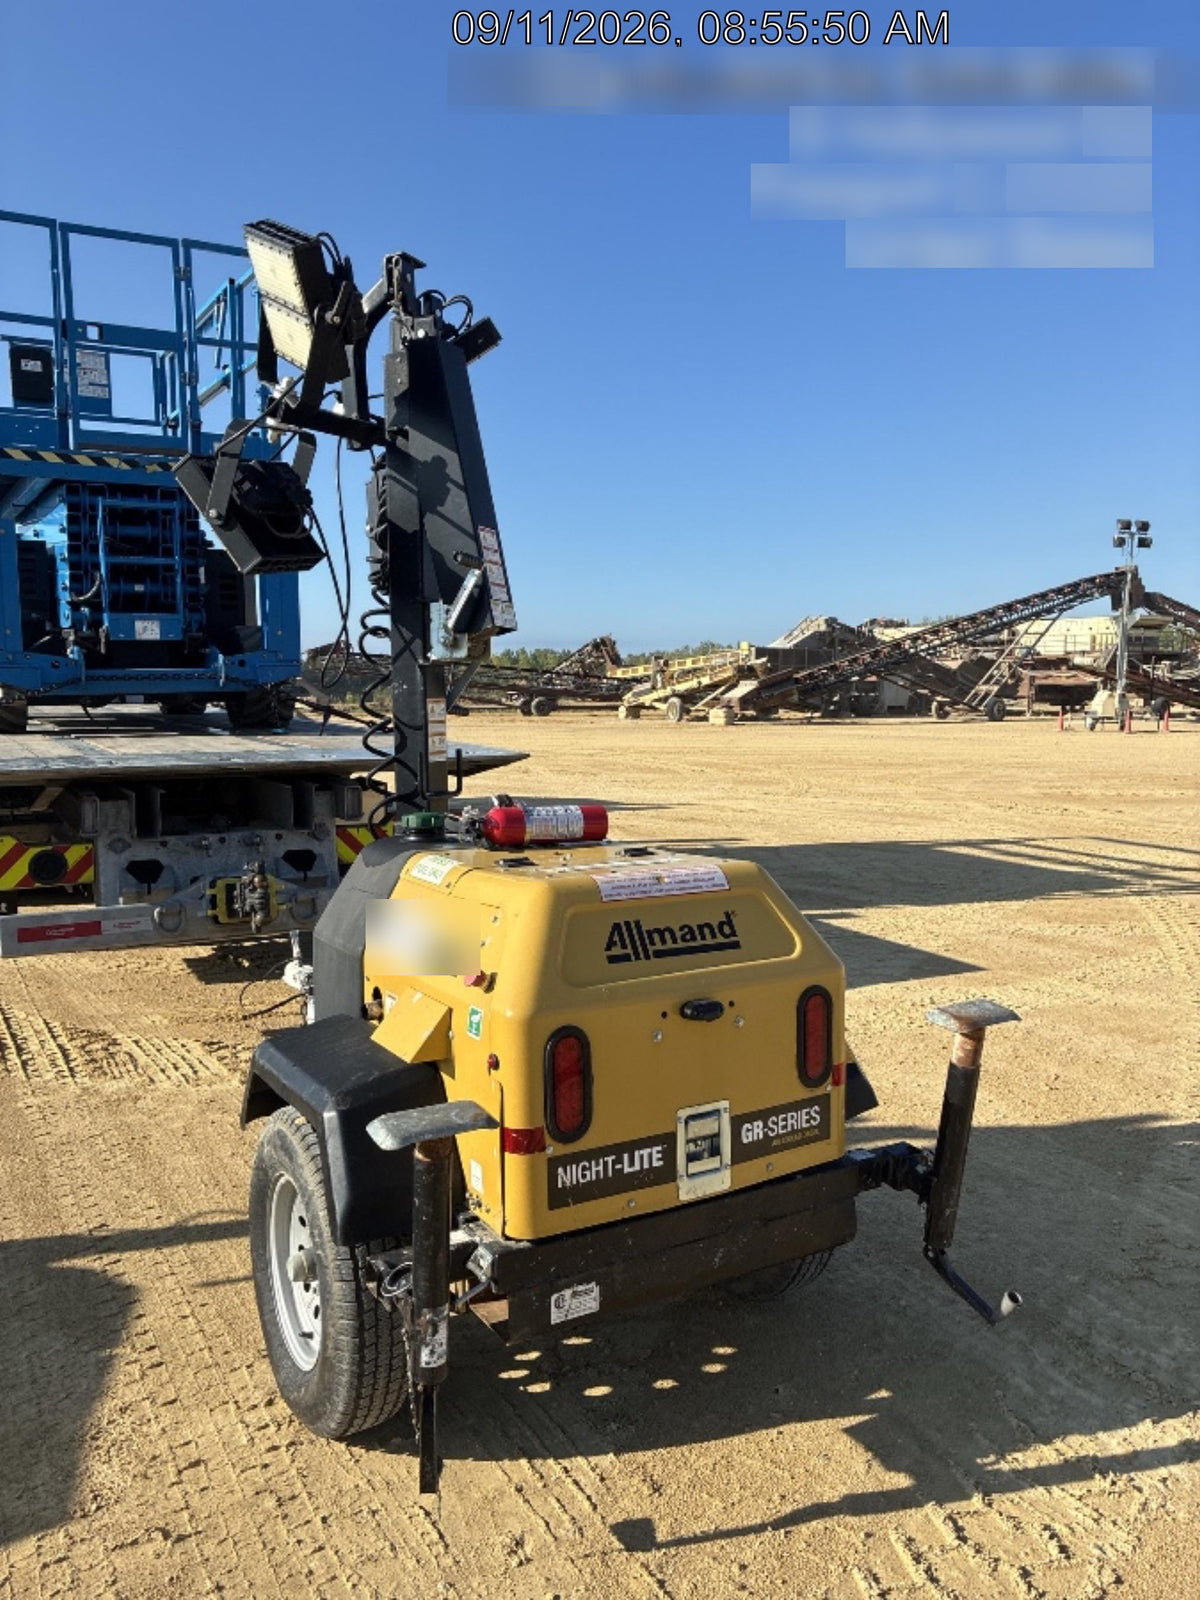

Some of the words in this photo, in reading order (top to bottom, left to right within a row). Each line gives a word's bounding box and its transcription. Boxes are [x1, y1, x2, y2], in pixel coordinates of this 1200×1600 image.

[604, 911, 738, 962] Allmand
[741, 1105, 821, 1144] GR-SERIES
[557, 1145, 665, 1189] NIGHT-LITE
